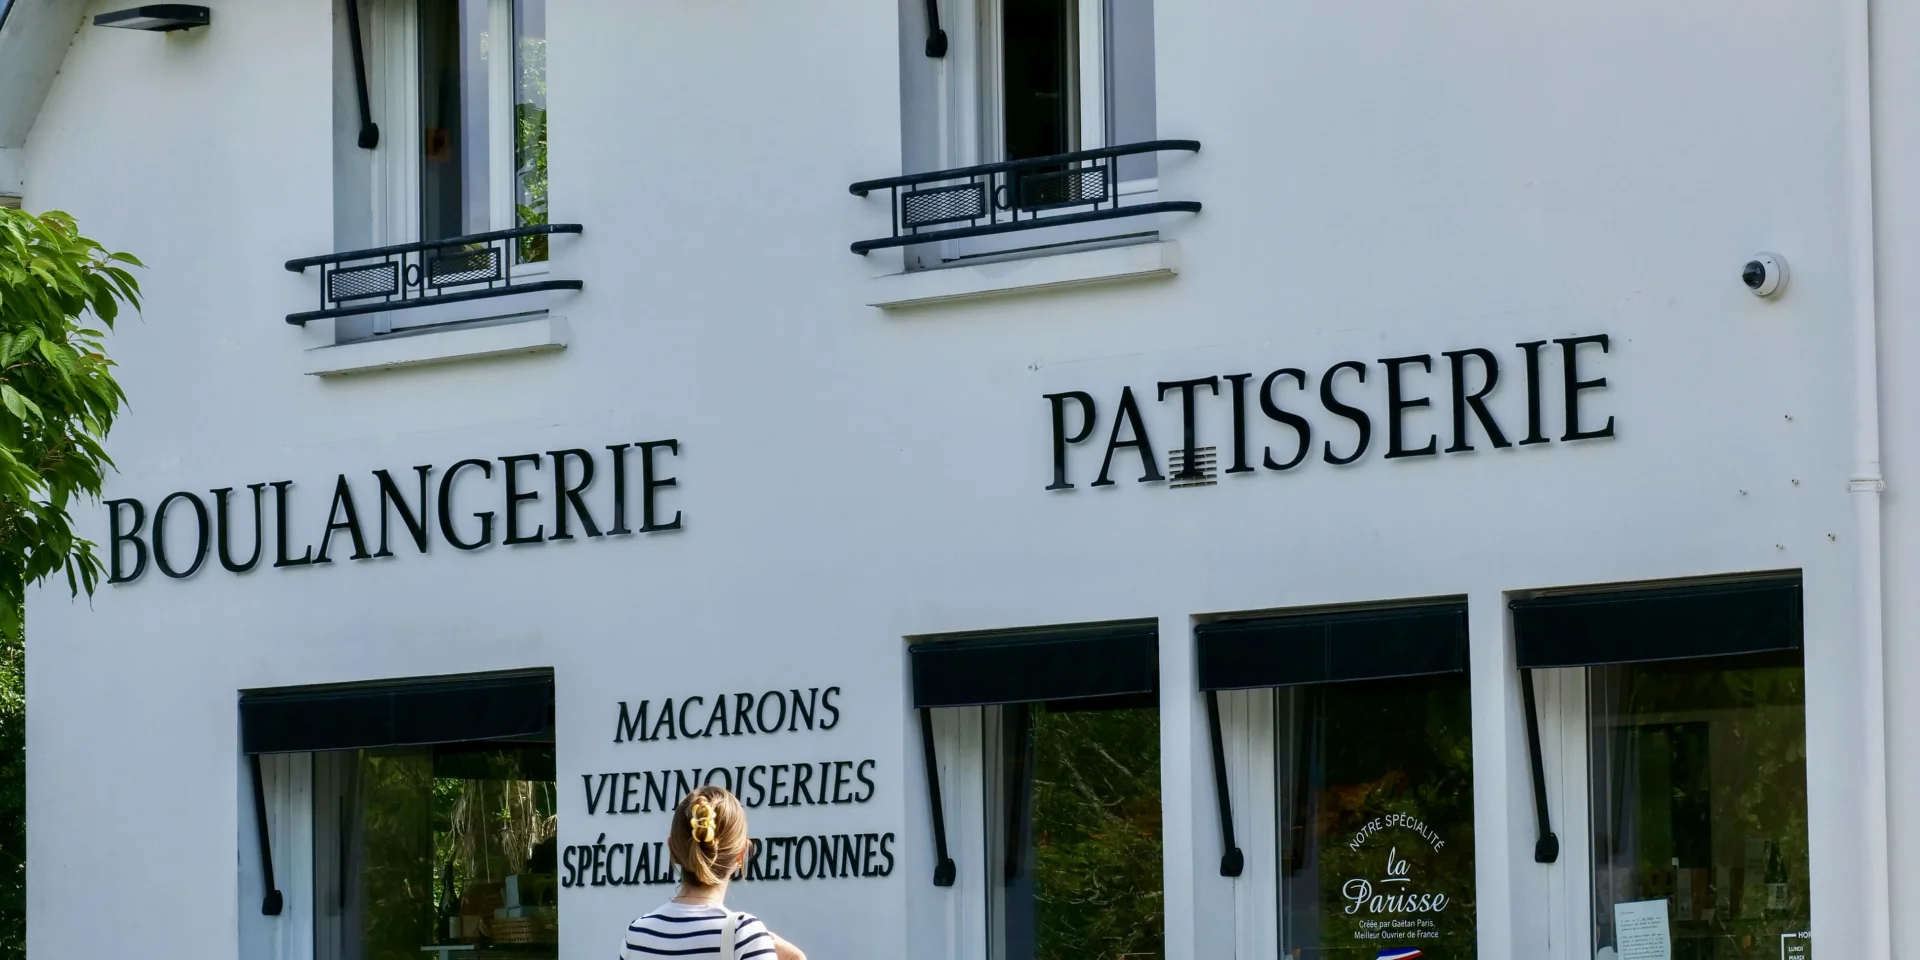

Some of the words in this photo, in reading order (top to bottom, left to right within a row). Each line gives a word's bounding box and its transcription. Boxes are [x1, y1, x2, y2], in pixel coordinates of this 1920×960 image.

[1042, 333, 1615, 491] PATISSERIE
[105, 438, 682, 584] BOULANGERIE
[613, 686, 841, 743] MACARONS
[1349, 817, 1383, 852] NOTRE
[1385, 811, 1445, 853] SPÉCIALITÉ
[561, 833, 684, 888] SPÉCIAL
[730, 832, 895, 882] RETONNES
[1387, 846, 1411, 876] la
[1342, 878, 1450, 915] Parisse
[1354, 931, 1380, 940] Meilleur
[1381, 930, 1406, 939] Ouvrier
[1406, 930, 1416, 939] de
[1416, 930, 1439, 938] France
[1379, 921, 1390, 930] par
